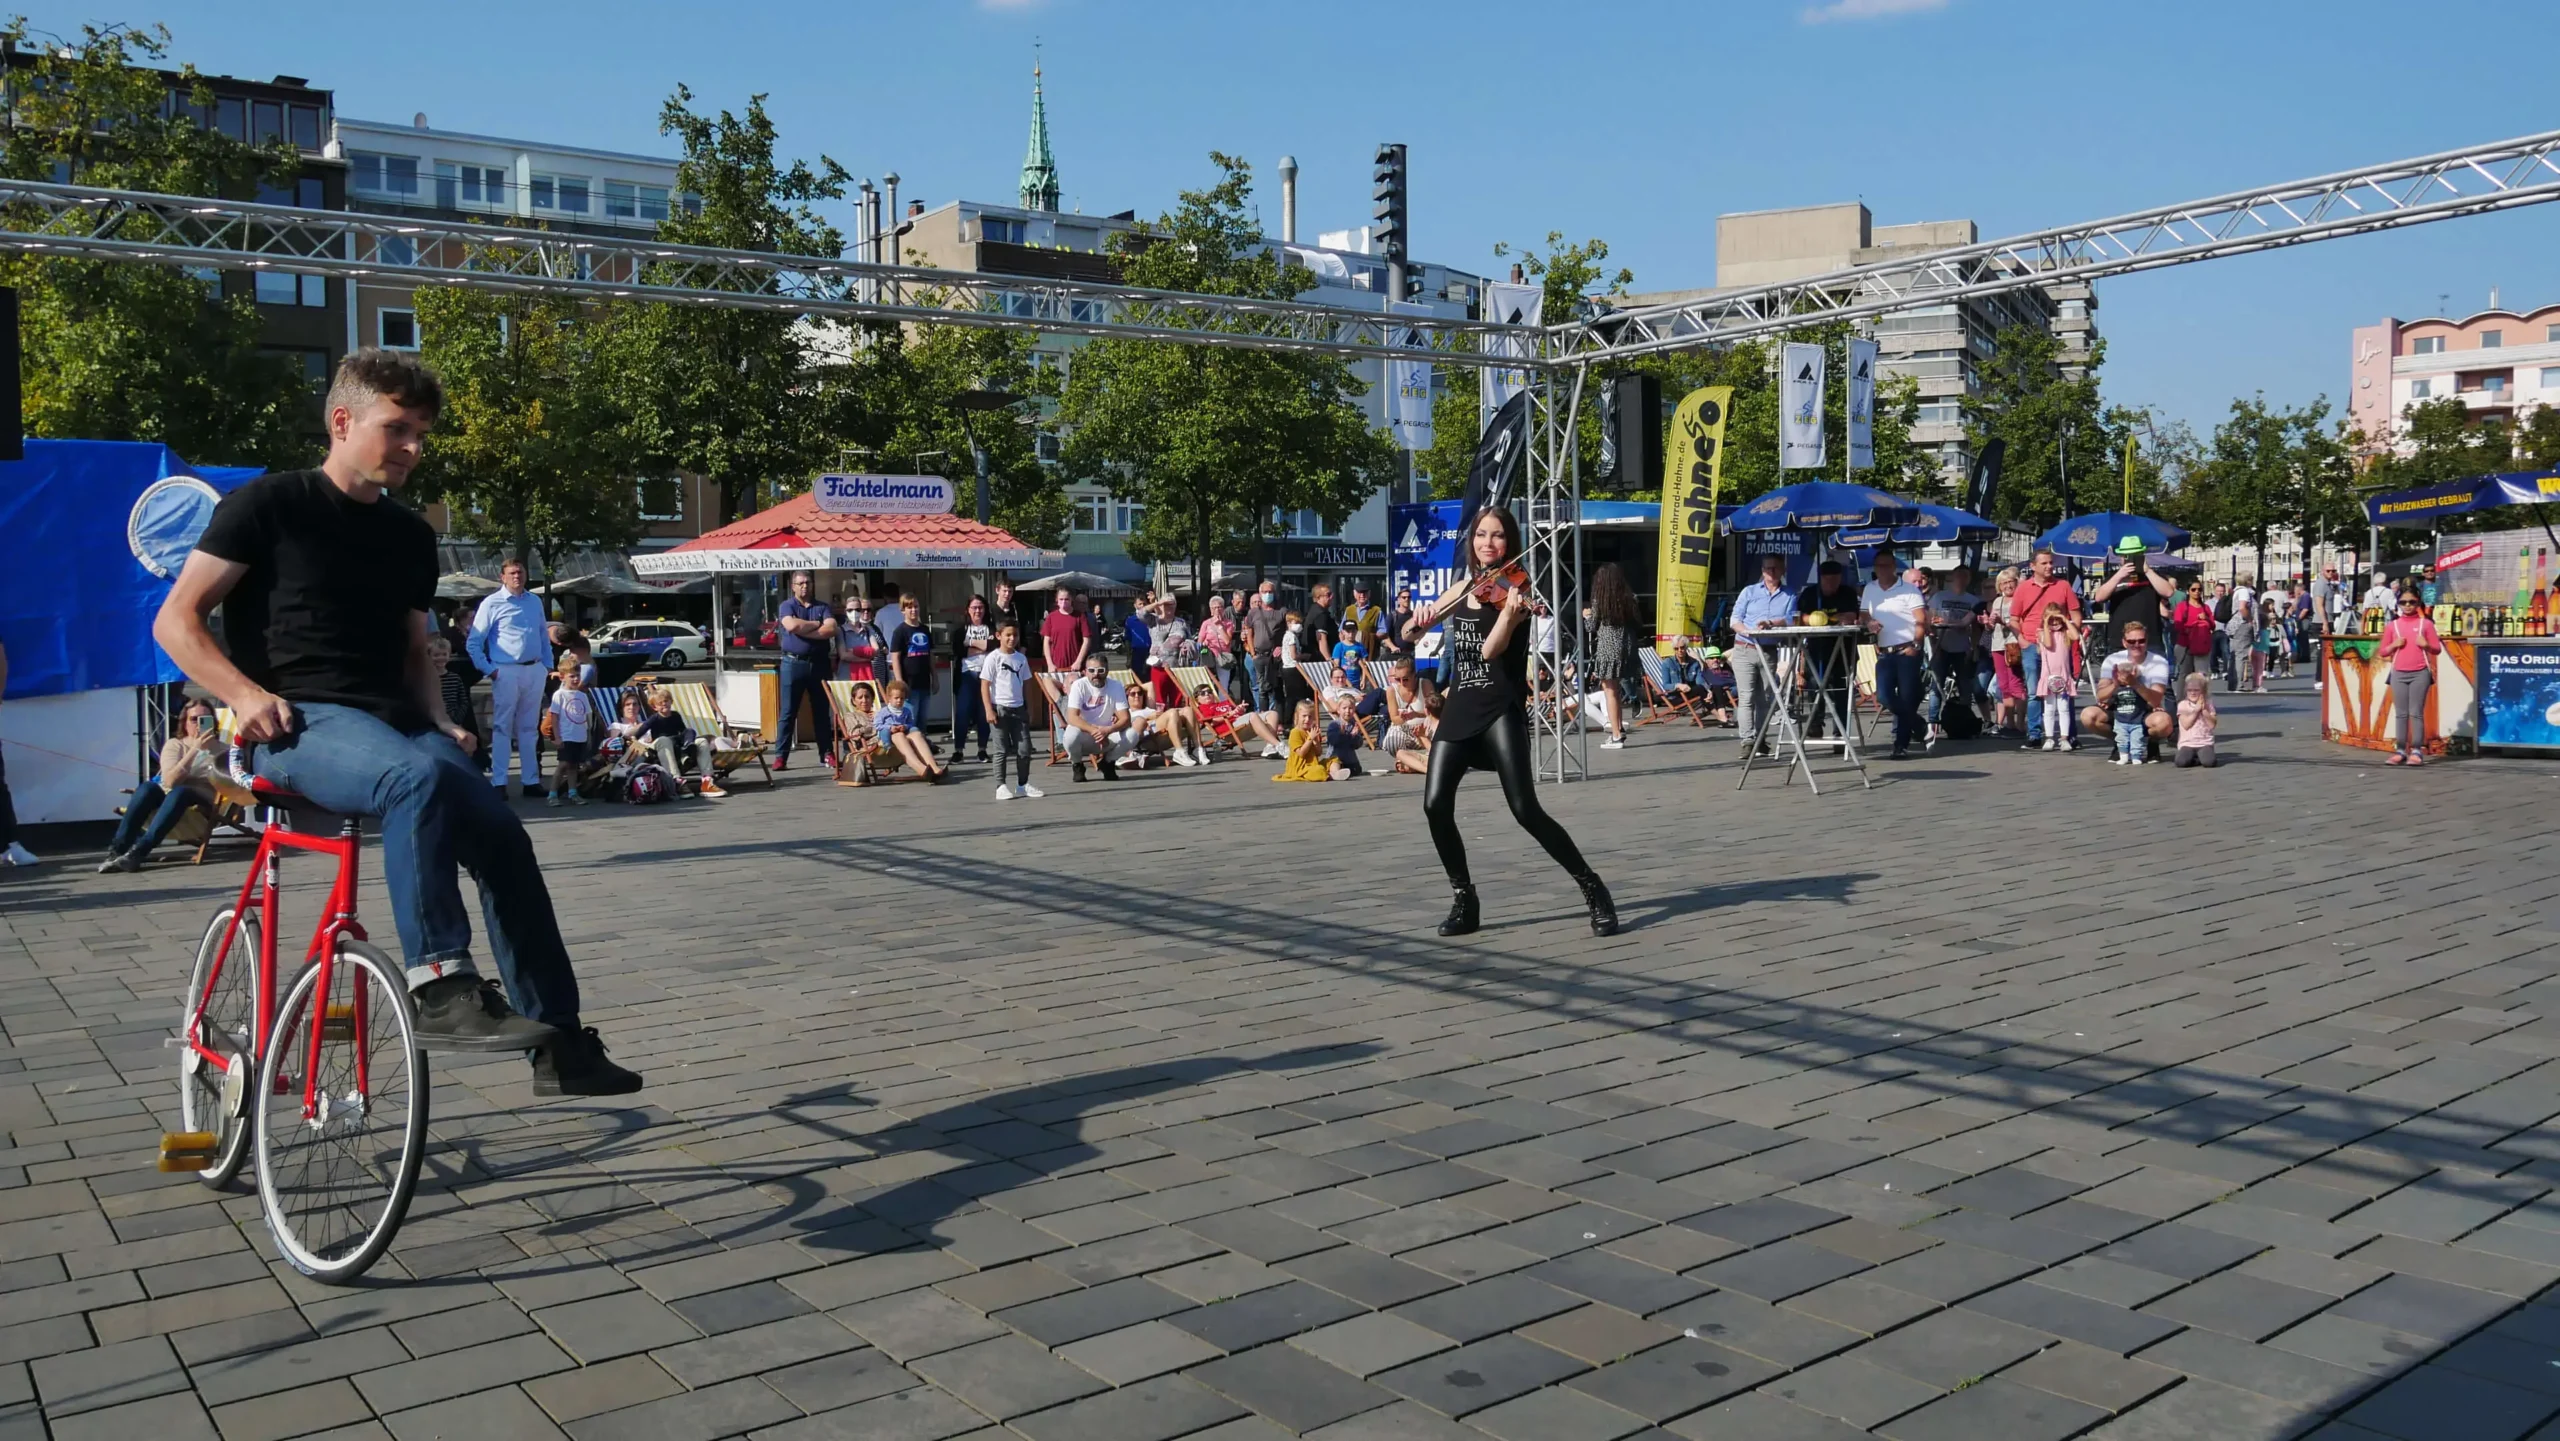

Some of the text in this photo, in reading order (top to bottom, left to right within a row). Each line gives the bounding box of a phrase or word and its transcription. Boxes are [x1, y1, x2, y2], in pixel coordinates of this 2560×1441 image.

[1401, 386, 1427, 399] ZEG
[824, 477, 944, 498] Fichtelmann
[1670, 440, 1687, 563] www.Fahrrad-Hahne.de
[1746, 542, 1801, 555] ROADSHOW
[915, 553, 962, 563] Fichtelmann
[1315, 547, 1367, 564] TAKSIM
[760, 557, 819, 570] Bratwurst
[836, 556, 890, 568] Bratwurst
[987, 557, 1035, 568] Bratwurst
[1461, 621, 1475, 631] DO
[1454, 631, 1486, 643] SMALL
[2490, 654, 2519, 665] DAS
[1457, 661, 1490, 673] GREAT
